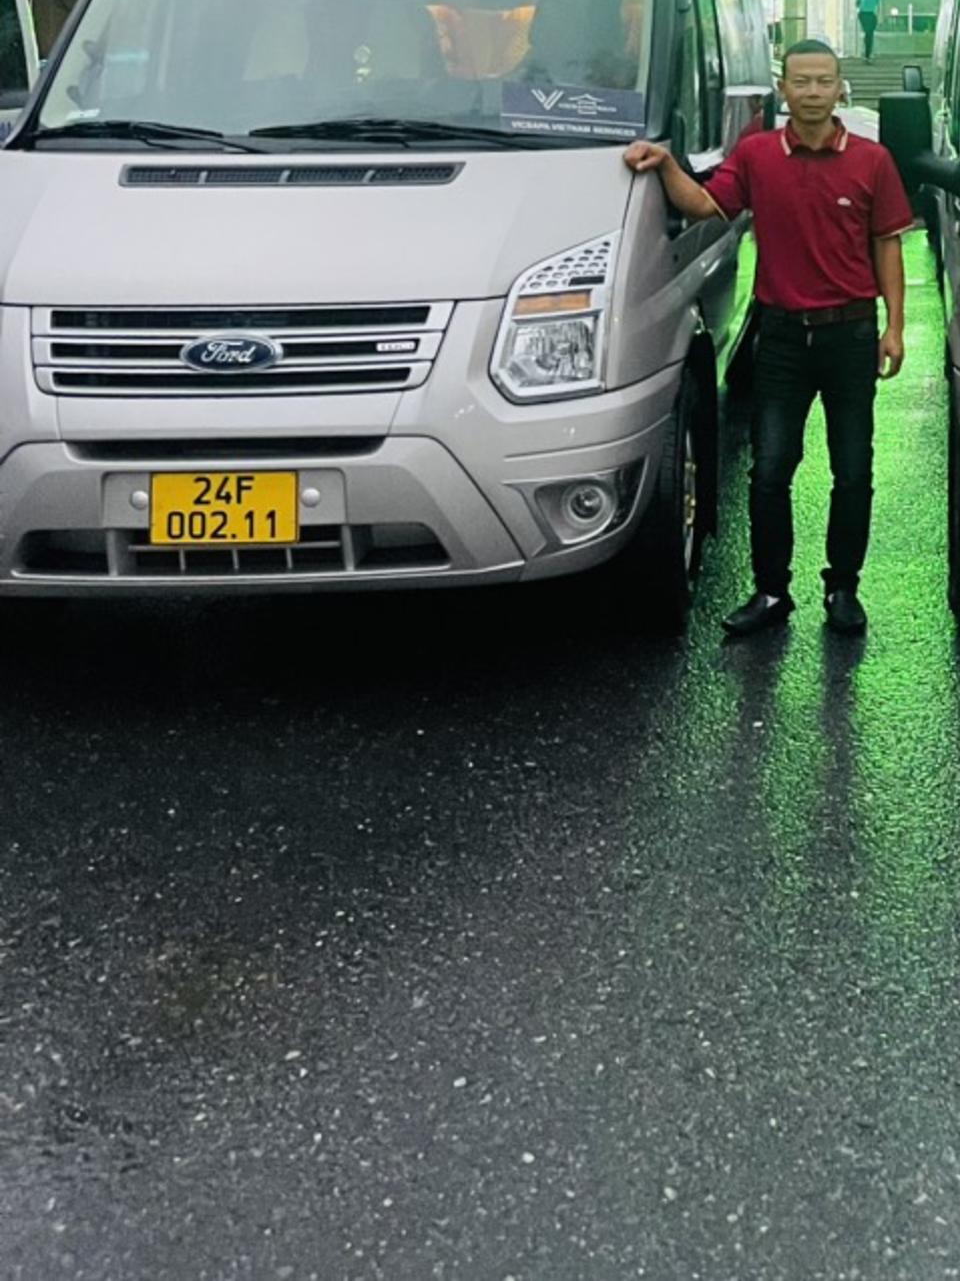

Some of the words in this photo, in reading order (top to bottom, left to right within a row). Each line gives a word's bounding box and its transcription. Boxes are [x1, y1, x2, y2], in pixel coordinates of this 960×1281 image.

[201, 340, 255, 363] Ford
[193, 476, 255, 505] 24F
[166, 509, 277, 540] 002.11
